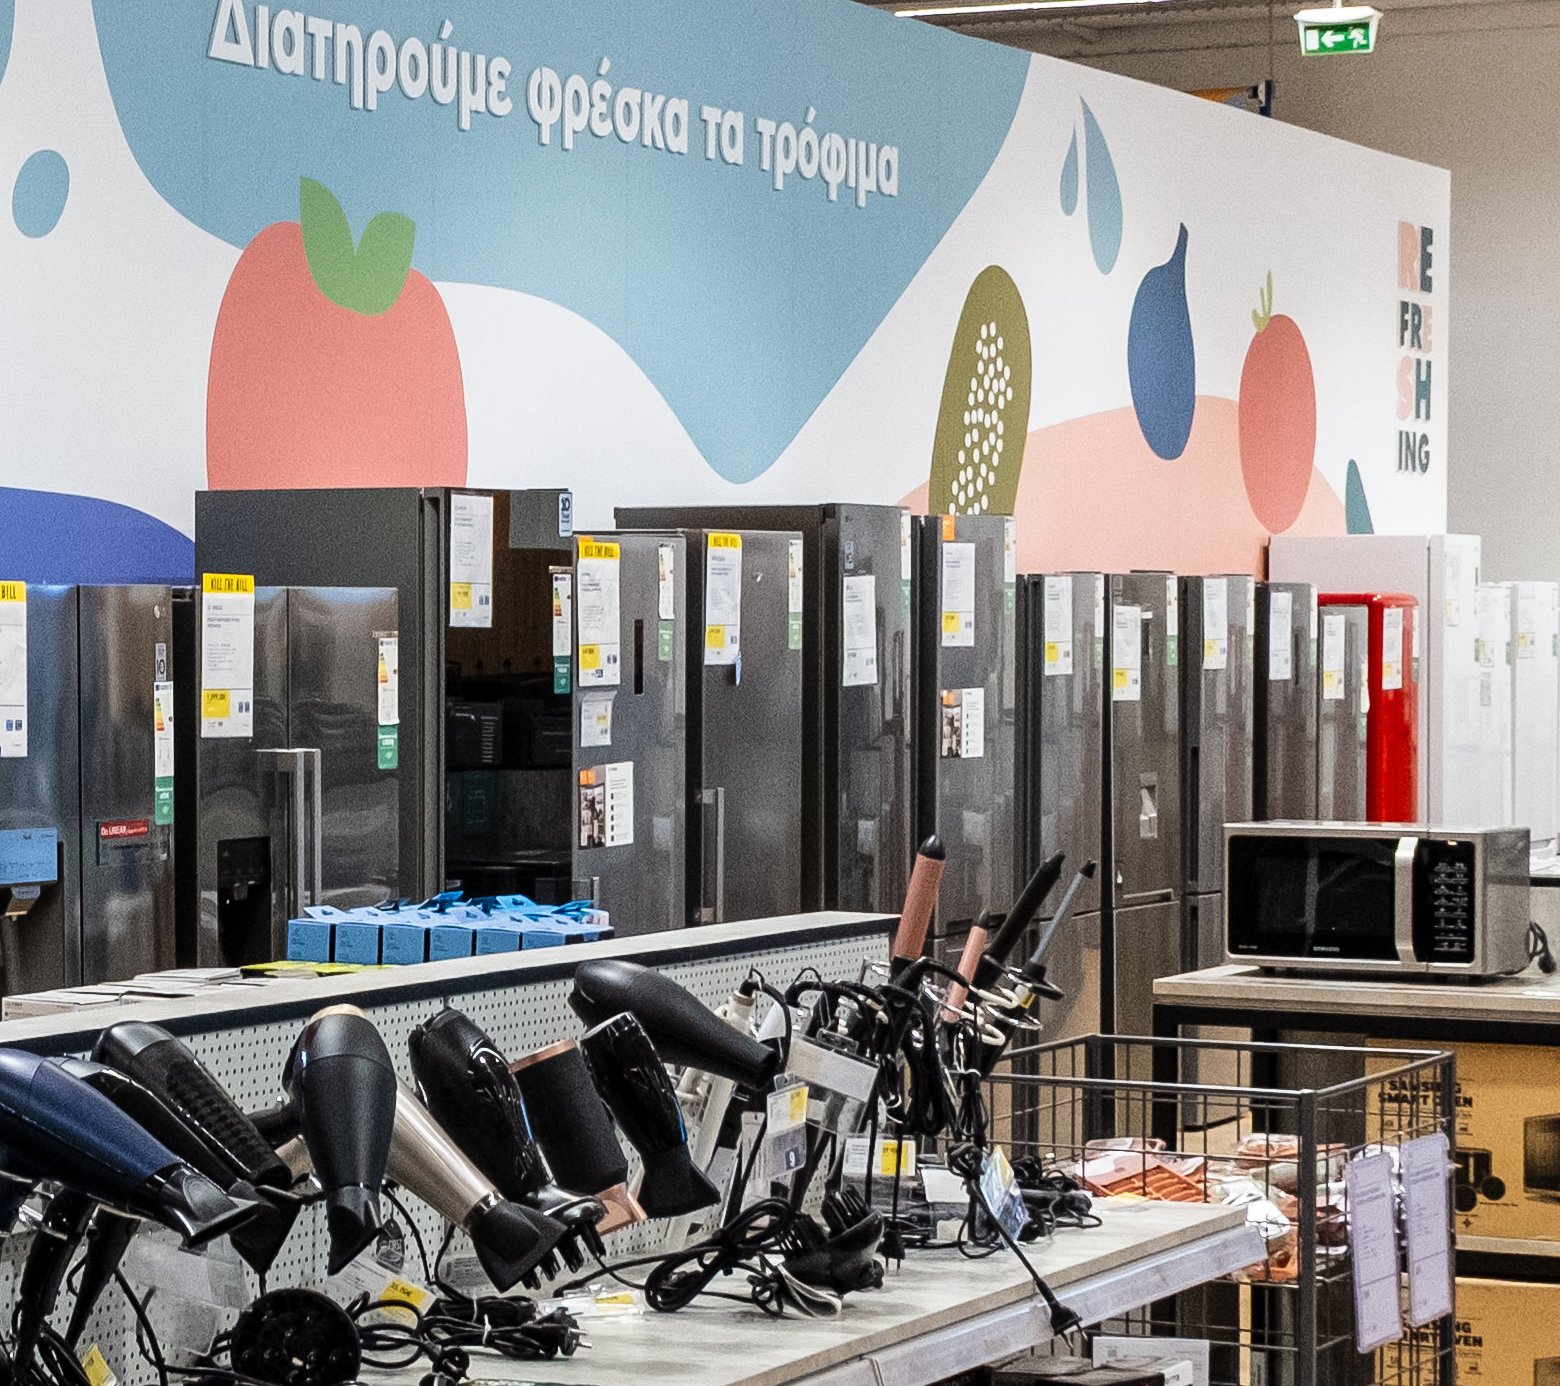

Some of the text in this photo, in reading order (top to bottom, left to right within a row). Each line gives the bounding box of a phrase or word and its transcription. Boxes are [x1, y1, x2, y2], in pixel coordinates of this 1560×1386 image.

[526, 56, 689, 153] φρέσκα
[699, 102, 745, 165] τα
[754, 105, 900, 207] τρόφιμα
[1397, 219, 1434, 293] RE
[1398, 300, 1433, 352] FRE
[1396, 430, 1431, 476] ING
[1, 585, 17, 600] BILL
